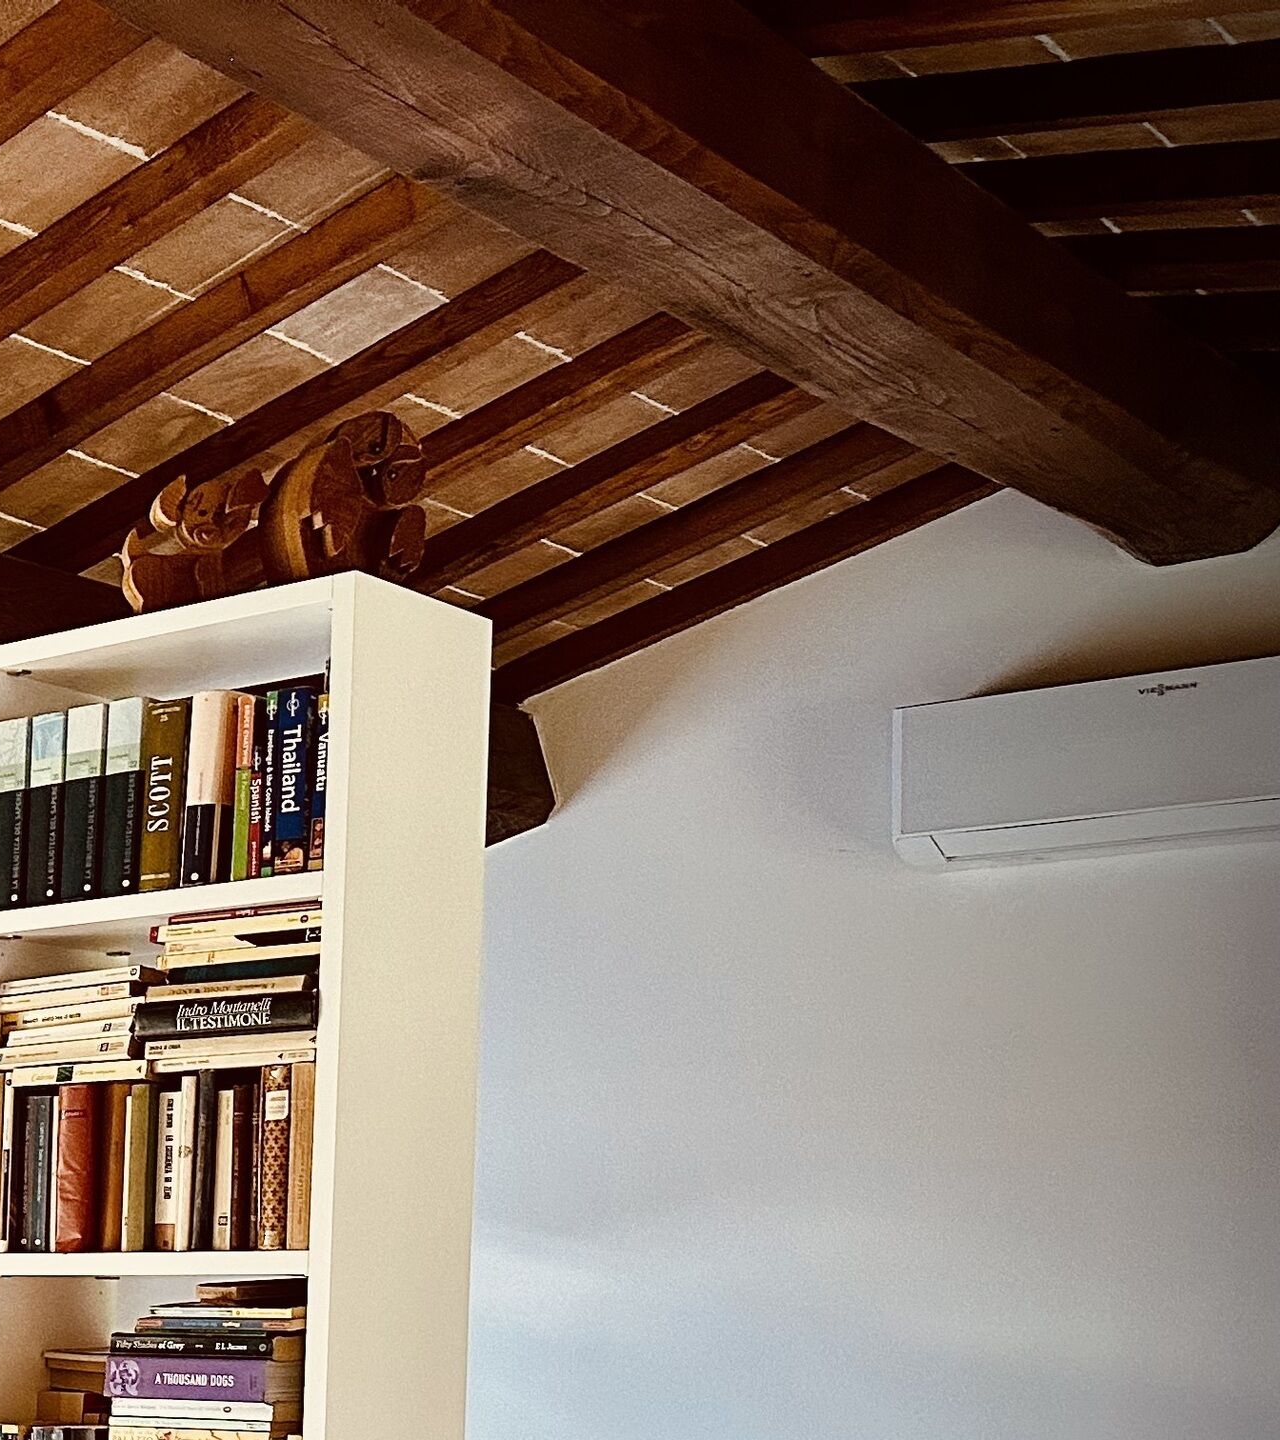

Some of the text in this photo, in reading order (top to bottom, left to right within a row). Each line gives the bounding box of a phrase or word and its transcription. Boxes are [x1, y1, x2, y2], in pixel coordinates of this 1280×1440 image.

[280, 724, 302, 813] Thailand
[315, 732, 329, 791] Vanuatu
[147, 756, 173, 832] SCOTT
[250, 780, 261, 823] Spanish
[176, 1012, 271, 1031] IL TESTIMONE
[177, 998, 272, 1019] Indro Montanelli
[116, 1340, 185, 1351] Fifty Shades of Grey
[155, 1373, 234, 1387] A THOUSAND DOGS
